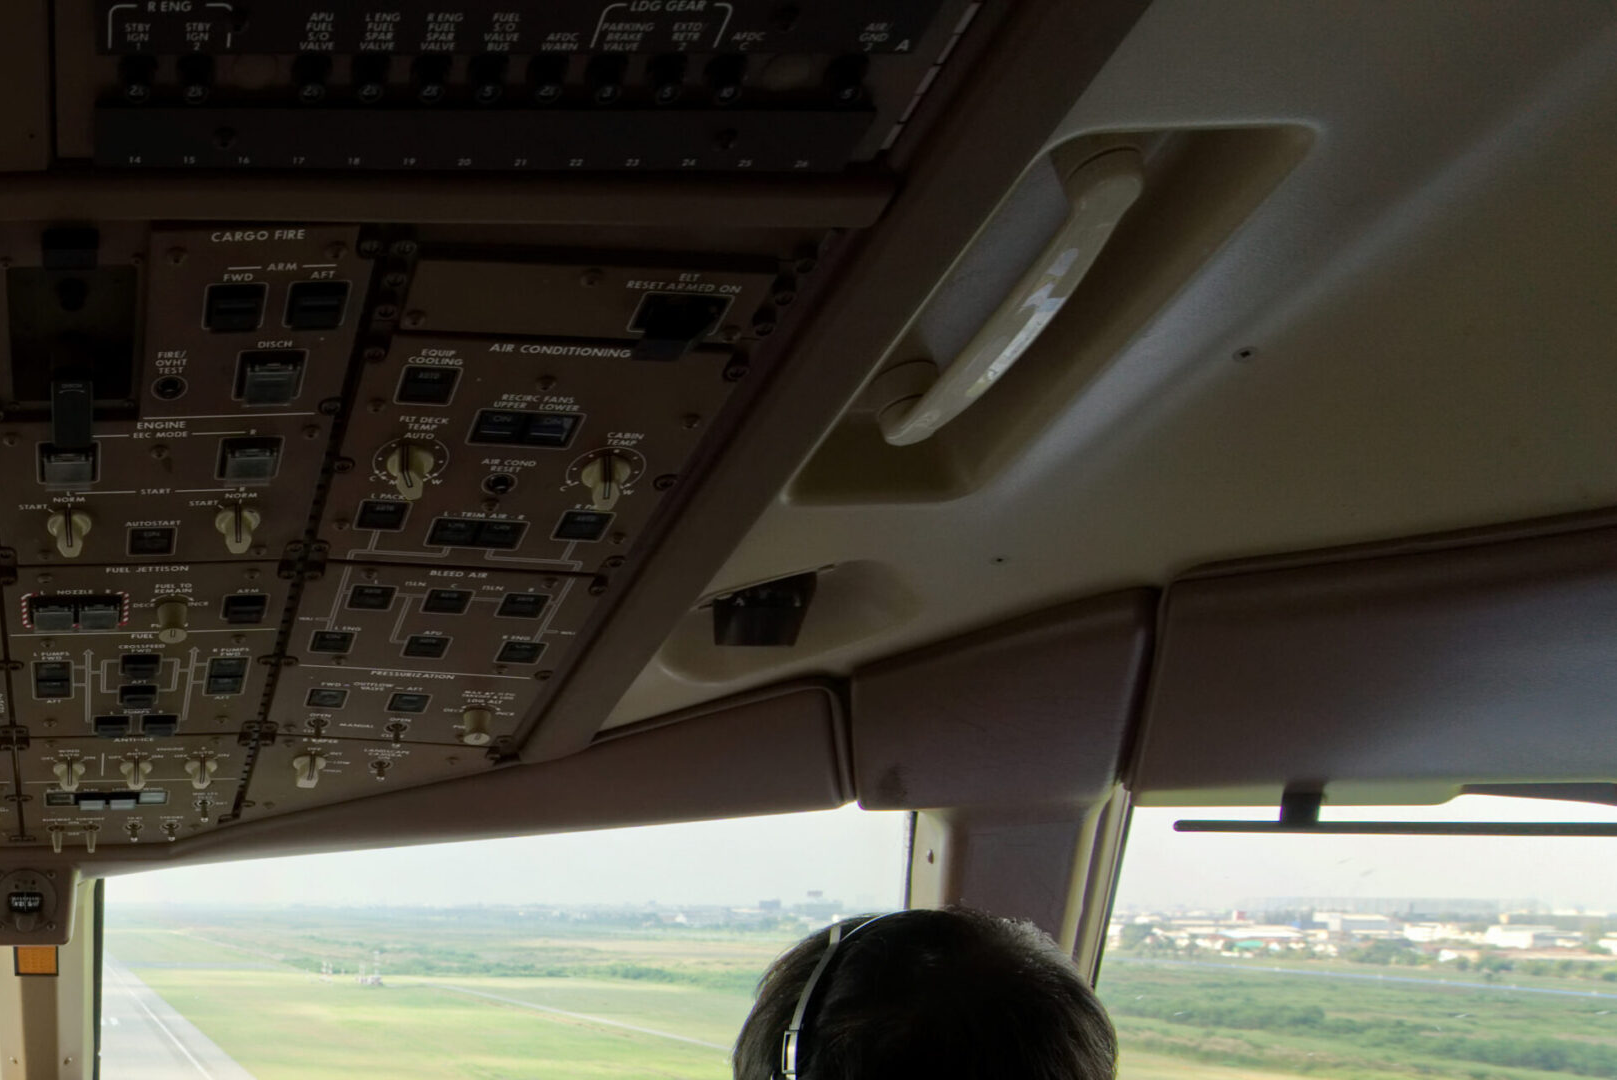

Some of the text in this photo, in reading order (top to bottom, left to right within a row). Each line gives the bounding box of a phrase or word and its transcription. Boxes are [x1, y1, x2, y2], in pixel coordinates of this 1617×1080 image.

[147, 1, 192, 13] R ENG
[630, 1, 706, 12] LDG GEAR
[374, 13, 401, 22] ENG
[437, 13, 464, 22] ENG
[493, 13, 520, 22] FUEL
[125, 23, 151, 32] STBY
[185, 23, 211, 32] STBY
[306, 23, 334, 32] FUEL
[367, 23, 395, 32] FUEL
[427, 23, 455, 32] FUEL
[602, 22, 655, 32] PARKING
[126, 33, 150, 42] IGN
[186, 33, 209, 42] IGN
[365, 32, 394, 42] SPAR
[484, 33, 519, 42] VALVE
[546, 32, 579, 42] AFDC
[605, 32, 643, 42] BRAKE
[732, 32, 766, 42] AFDC
[299, 42, 335, 51] VALVE
[360, 42, 395, 51] VALVE
[420, 42, 456, 51] VALVE
[541, 42, 579, 51] WARN
[603, 42, 639, 51] VALVE
[895, 39, 910, 51] A
[211, 229, 306, 242] CARGO FIRE
[267, 262, 298, 271] ARM
[223, 273, 254, 282] FWD
[310, 270, 336, 279] AFT
[679, 273, 701, 282] ELT
[626, 280, 743, 294] RESET ARMED ON
[257, 340, 293, 349] DISCH
[157, 350, 186, 359] FIRE/
[421, 348, 456, 357] EQUIP
[490, 343, 632, 359] AIR CONDITIONING
[155, 358, 187, 367] OVHT
[408, 357, 464, 366] COOLING
[158, 366, 184, 375] TEST
[501, 393, 576, 404] RECIRC FANS
[493, 401, 528, 409] UPPER
[539, 403, 580, 412] LOWER
[400, 415, 450, 425] FLT DECK
[136, 421, 187, 430] ENGINE
[407, 422, 438, 432] TEMP
[133, 430, 189, 439] EEC MODE
[404, 432, 435, 440] AUTO
[607, 431, 645, 440] CABIN
[481, 458, 538, 467] AIR COND
[490, 465, 521, 474] RESET
[140, 487, 171, 495] START
[53, 496, 86, 504] NORM
[189, 500, 219, 508] START
[18, 504, 48, 512] START
[461, 511, 487, 519] TRIM
[125, 520, 181, 528] AUTOSTART
[135, 565, 189, 573] JETTISON
[430, 569, 488, 580] BLEED AIR
[371, 669, 455, 680] PRESSURIZATION
